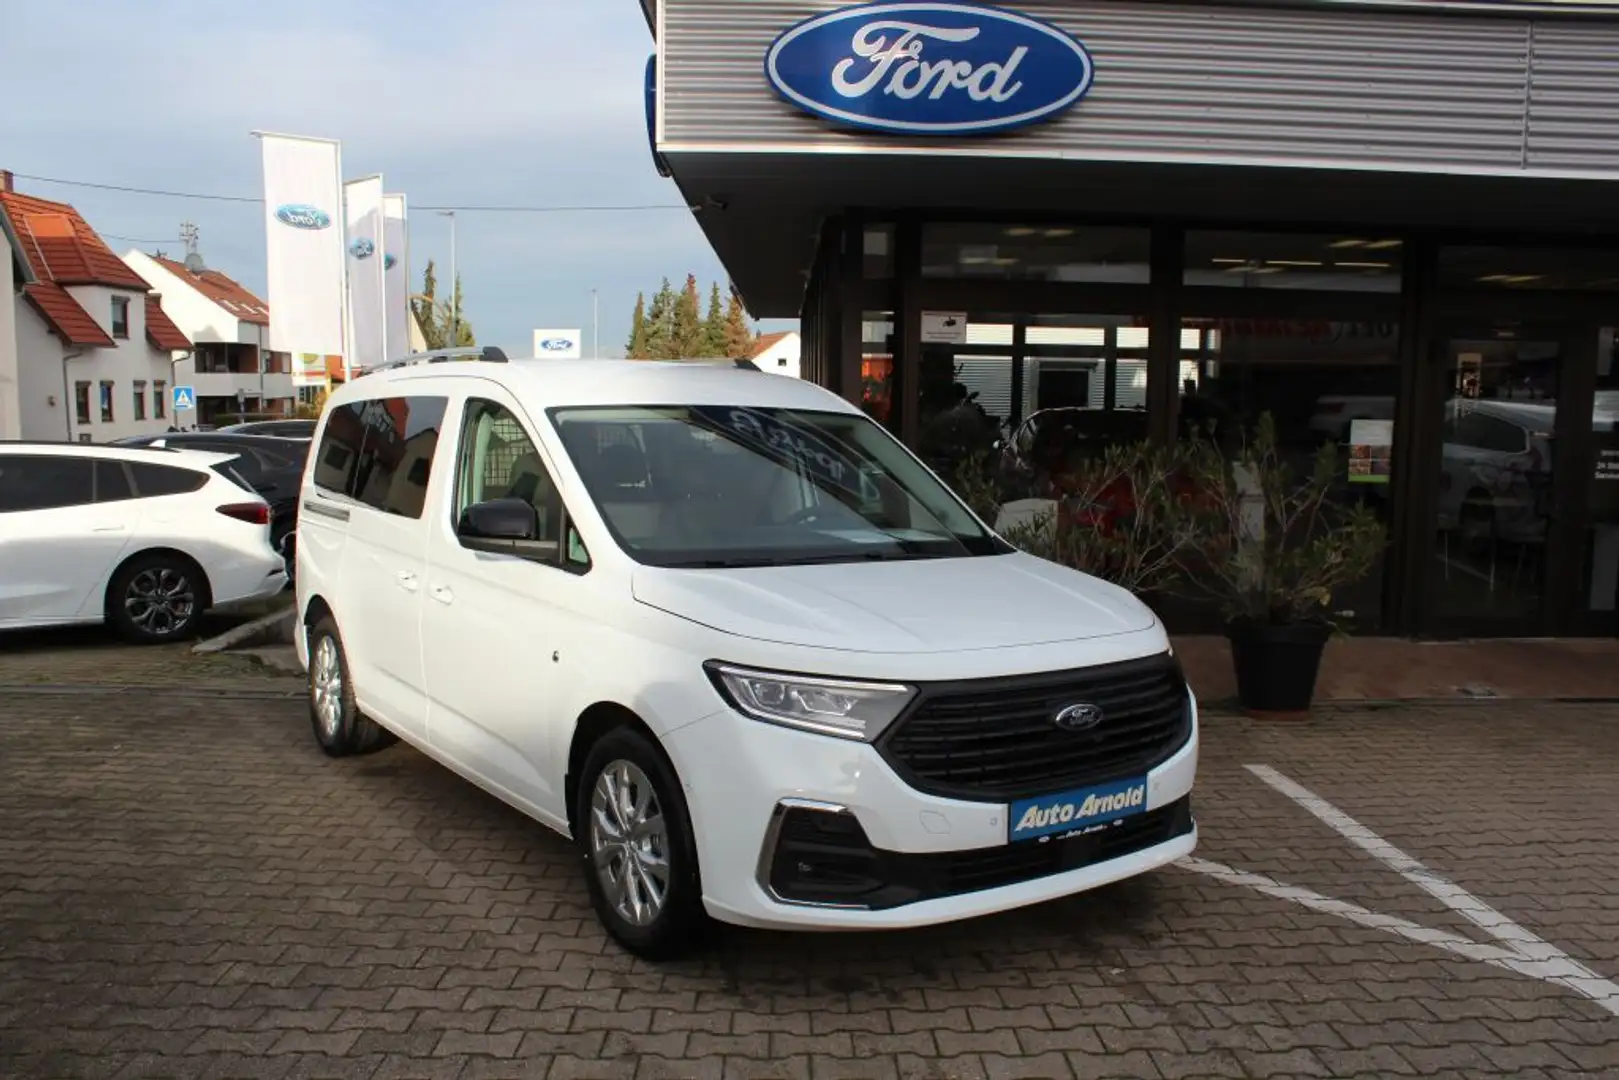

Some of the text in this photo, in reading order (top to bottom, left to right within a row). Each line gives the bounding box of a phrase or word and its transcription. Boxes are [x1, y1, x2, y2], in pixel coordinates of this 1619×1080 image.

[831, 20, 1029, 103] Ford
[1069, 708, 1096, 726] Ford
[1014, 784, 1145, 832] Auto Arnold
